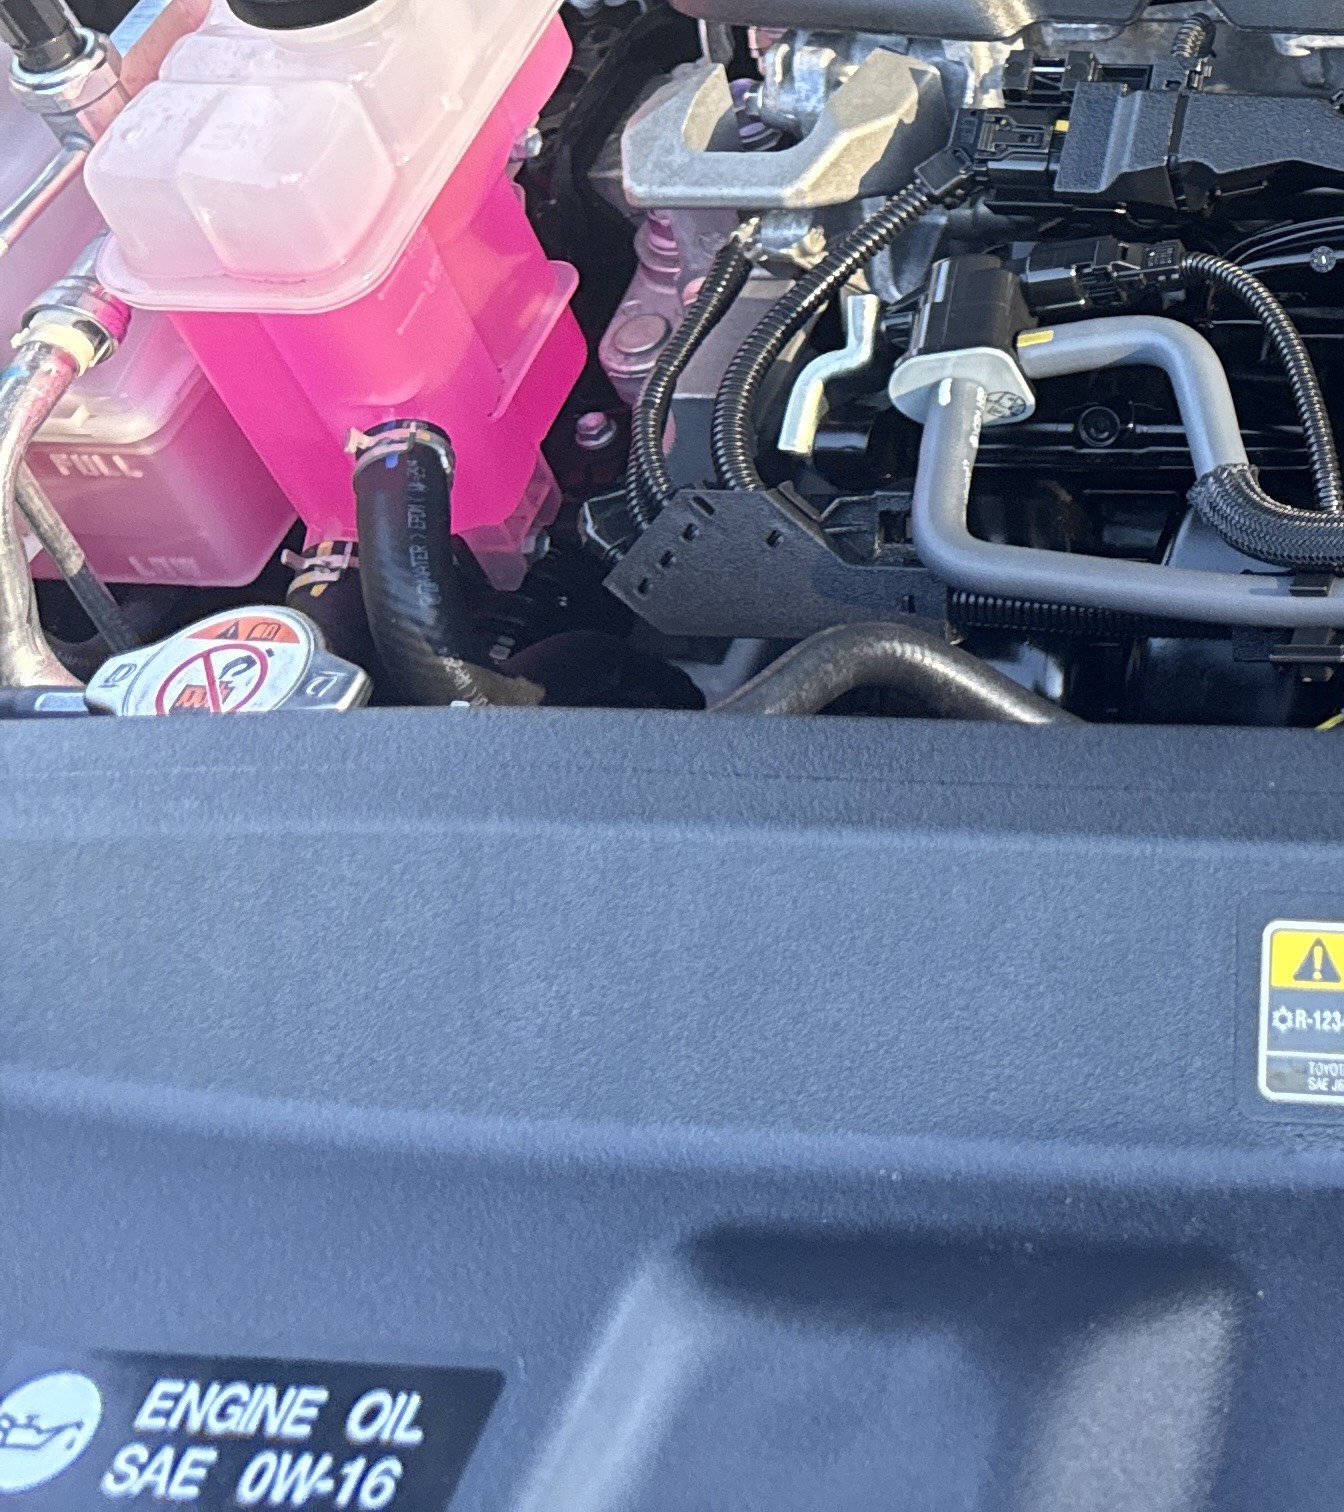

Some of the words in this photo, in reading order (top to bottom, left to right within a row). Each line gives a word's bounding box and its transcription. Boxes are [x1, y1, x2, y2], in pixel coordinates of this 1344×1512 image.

[50, 453, 143, 478] FULL
[1308, 1077, 1329, 1091] SAE
[133, 1377, 330, 1439] ENGINE
[345, 1388, 424, 1445] OIL
[101, 1443, 219, 1500] SAE
[235, 1450, 403, 1510] 0W-16
